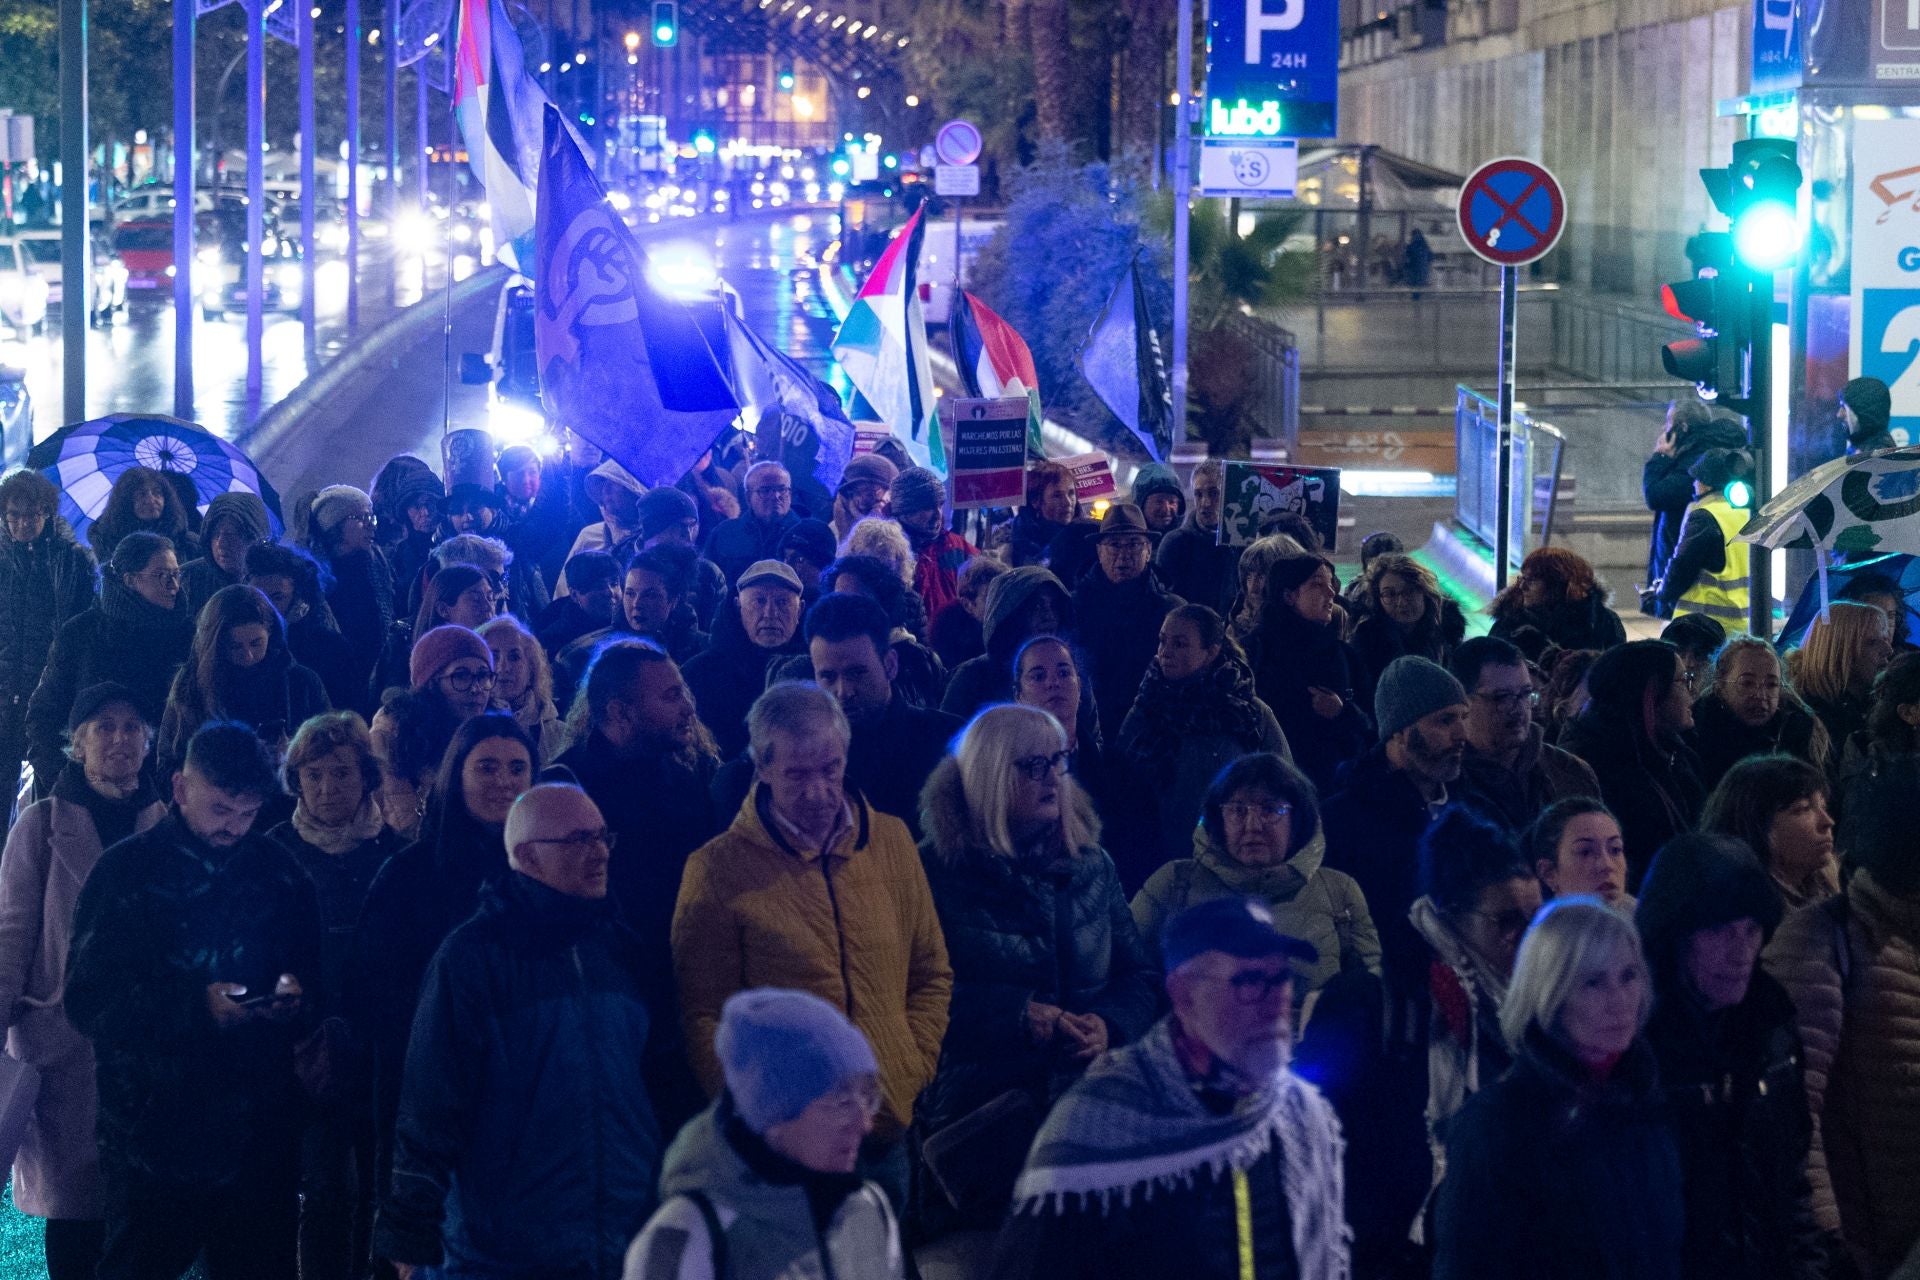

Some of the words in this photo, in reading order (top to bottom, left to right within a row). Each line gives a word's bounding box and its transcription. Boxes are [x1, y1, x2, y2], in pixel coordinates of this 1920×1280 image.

[1245, 0, 1304, 64] P
[1271, 52, 1307, 68] 24H
[961, 431, 997, 440] MARCHEMOS
[999, 430, 1010, 440] POR
[1011, 429, 1022, 439] LAS
[958, 446, 988, 456] MUJERES
[989, 444, 1023, 455] PALESTINAS
